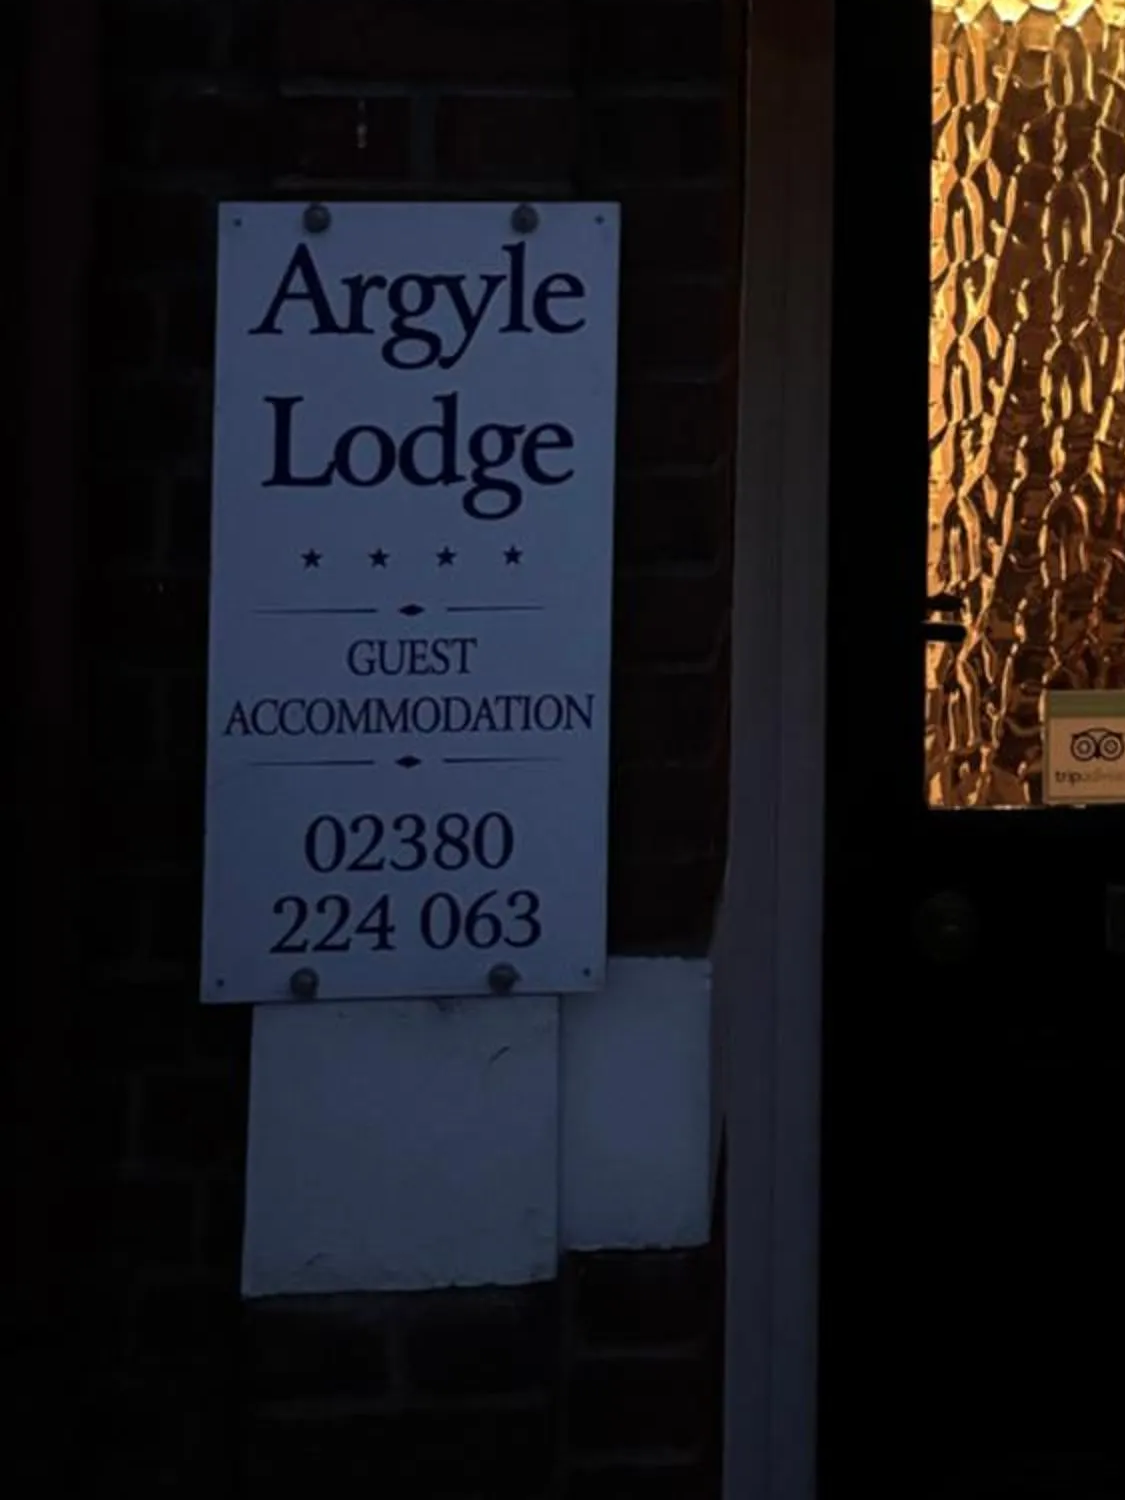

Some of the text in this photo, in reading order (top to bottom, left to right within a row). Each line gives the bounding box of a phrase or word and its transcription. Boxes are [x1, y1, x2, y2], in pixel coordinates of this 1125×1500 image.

[247, 240, 586, 371] Argyle
[260, 390, 575, 521] Lodge
[345, 636, 478, 677] GUEST
[222, 693, 595, 737] ACCOMMODATION
[303, 811, 515, 874] 02380
[268, 889, 542, 955] 224 063
